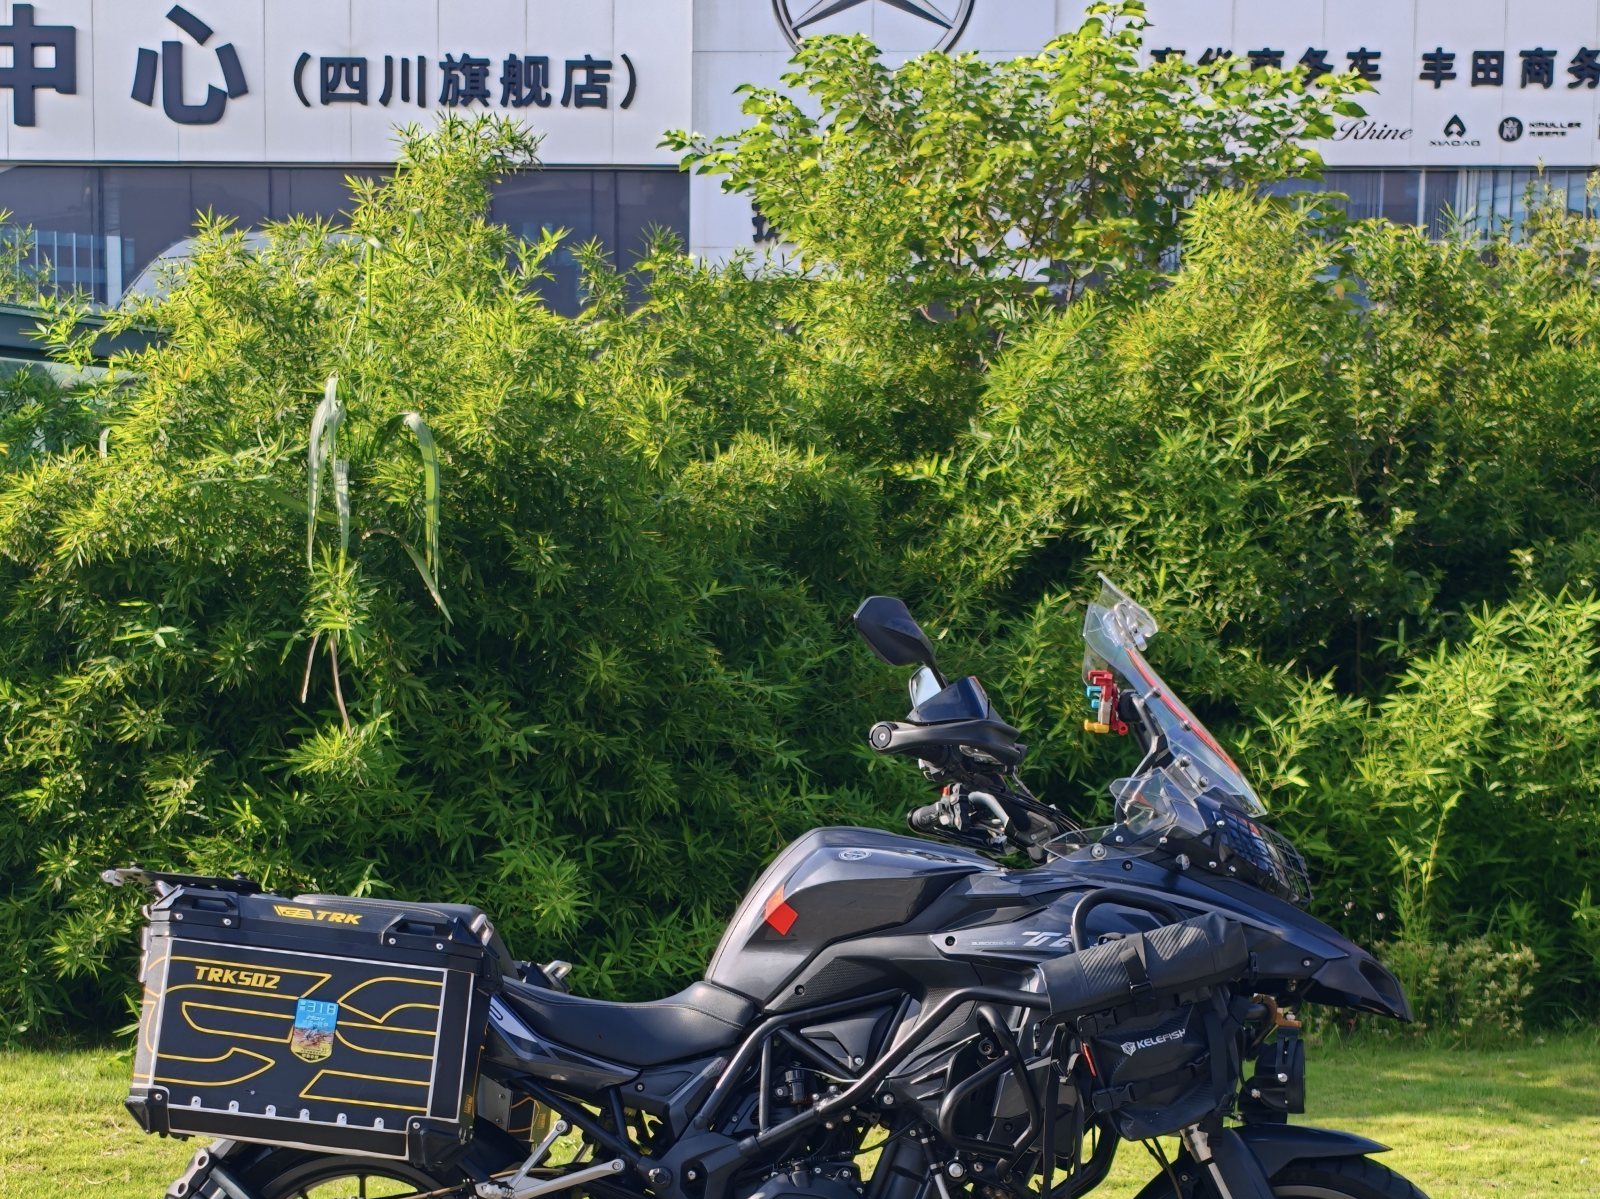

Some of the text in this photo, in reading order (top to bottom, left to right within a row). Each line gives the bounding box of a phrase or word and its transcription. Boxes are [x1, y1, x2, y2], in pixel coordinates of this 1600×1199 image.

[316, 910, 363, 925] TRK
[195, 966, 280, 989] TRK502
[1136, 1028, 1186, 1049] KELEFISH
